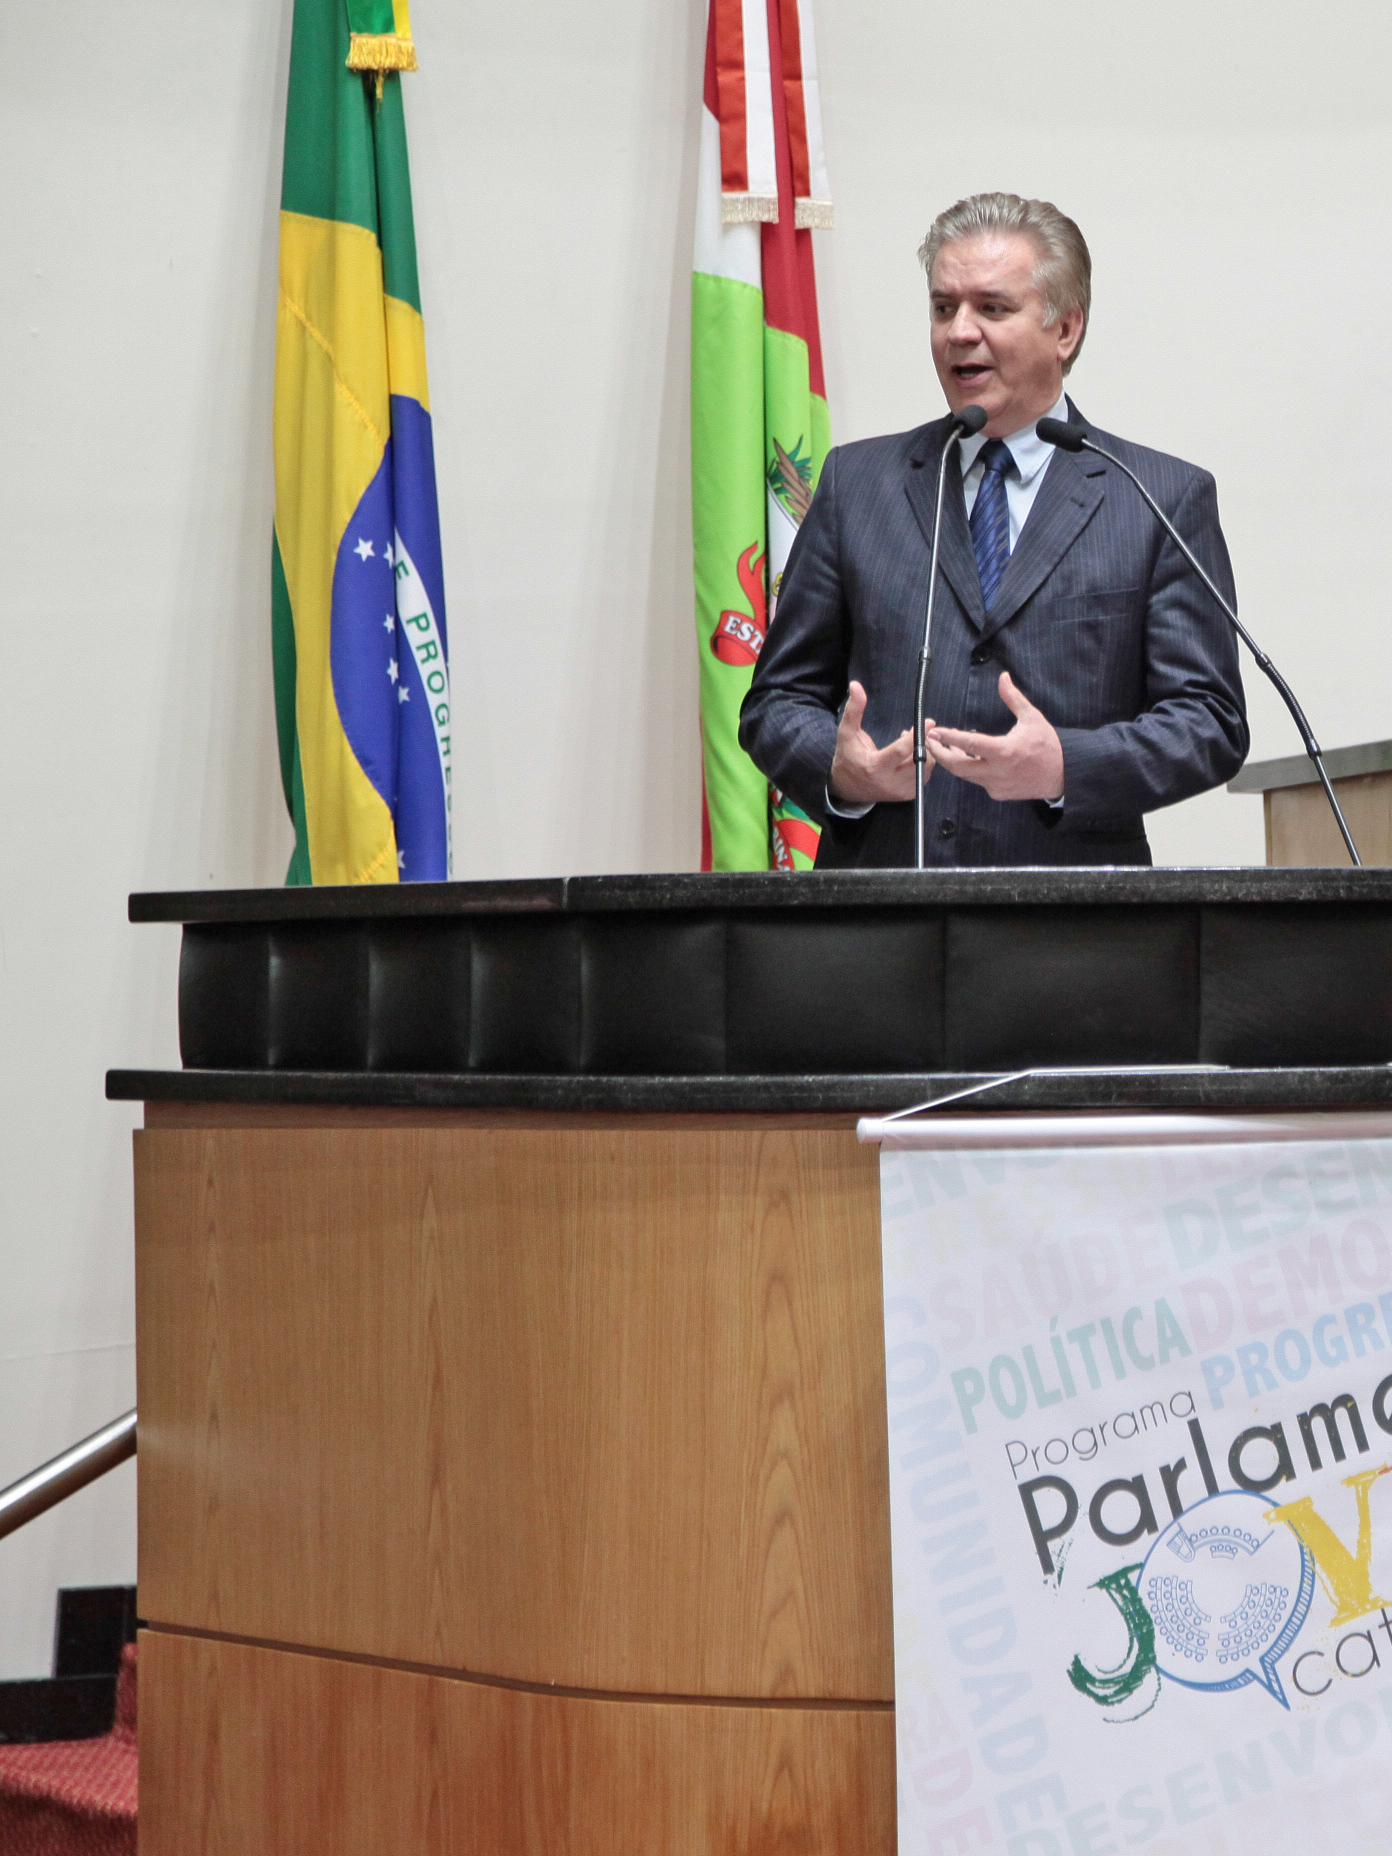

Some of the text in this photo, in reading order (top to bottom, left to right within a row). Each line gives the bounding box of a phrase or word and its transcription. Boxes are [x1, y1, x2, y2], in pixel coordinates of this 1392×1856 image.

[950, 1296, 1192, 1435] POLÍTICA
[1004, 1390, 1197, 1480] Programa
[884, 1294, 1069, 1834] COMUNIDADE
